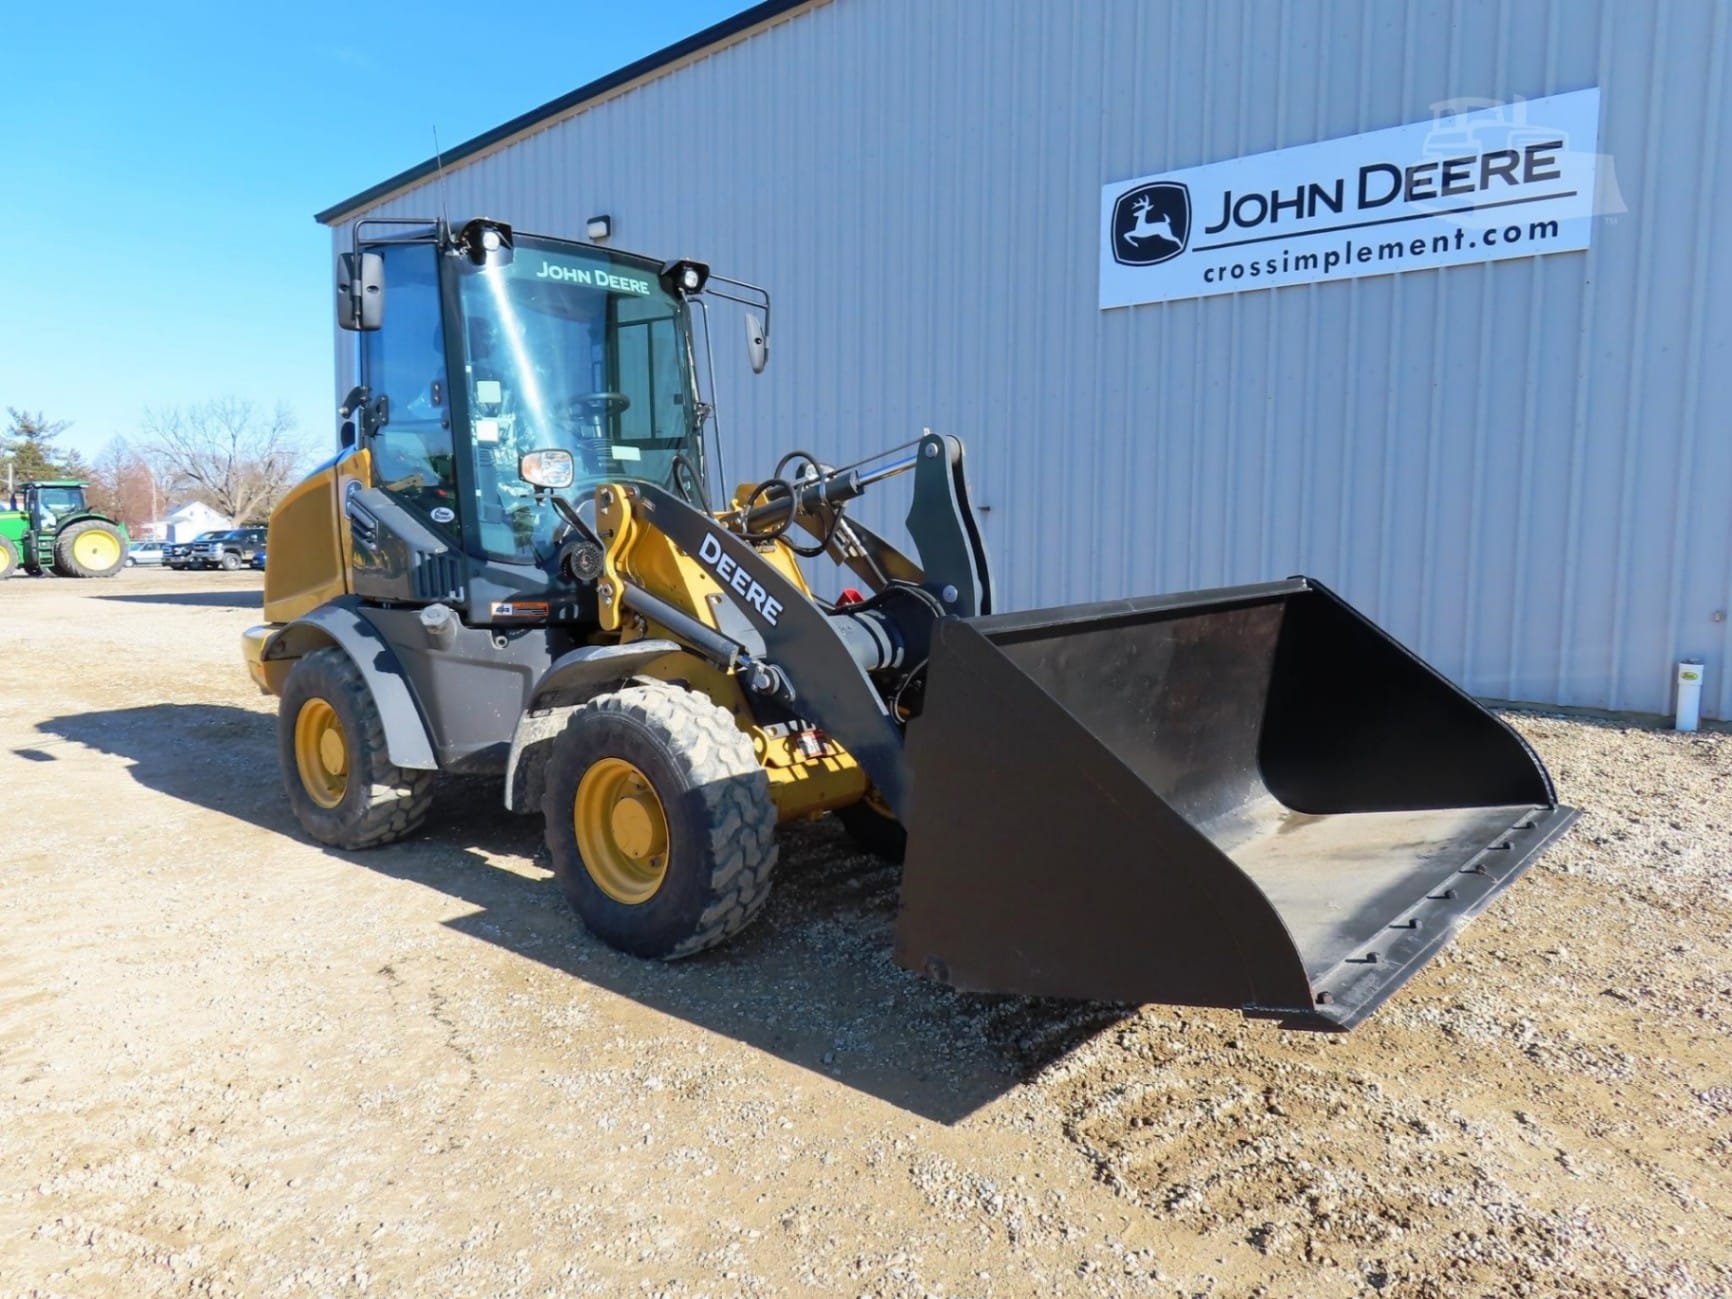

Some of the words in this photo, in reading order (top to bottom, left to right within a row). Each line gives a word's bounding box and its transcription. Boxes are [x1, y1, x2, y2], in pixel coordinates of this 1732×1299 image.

[1204, 179, 1344, 234] JOHN
[1358, 140, 1563, 210] DEERE
[536, 261, 592, 284] JOHN
[594, 269, 650, 295] DEERE
[1203, 220, 1559, 283] crossimplement.com
[698, 532, 784, 627] DEERE
